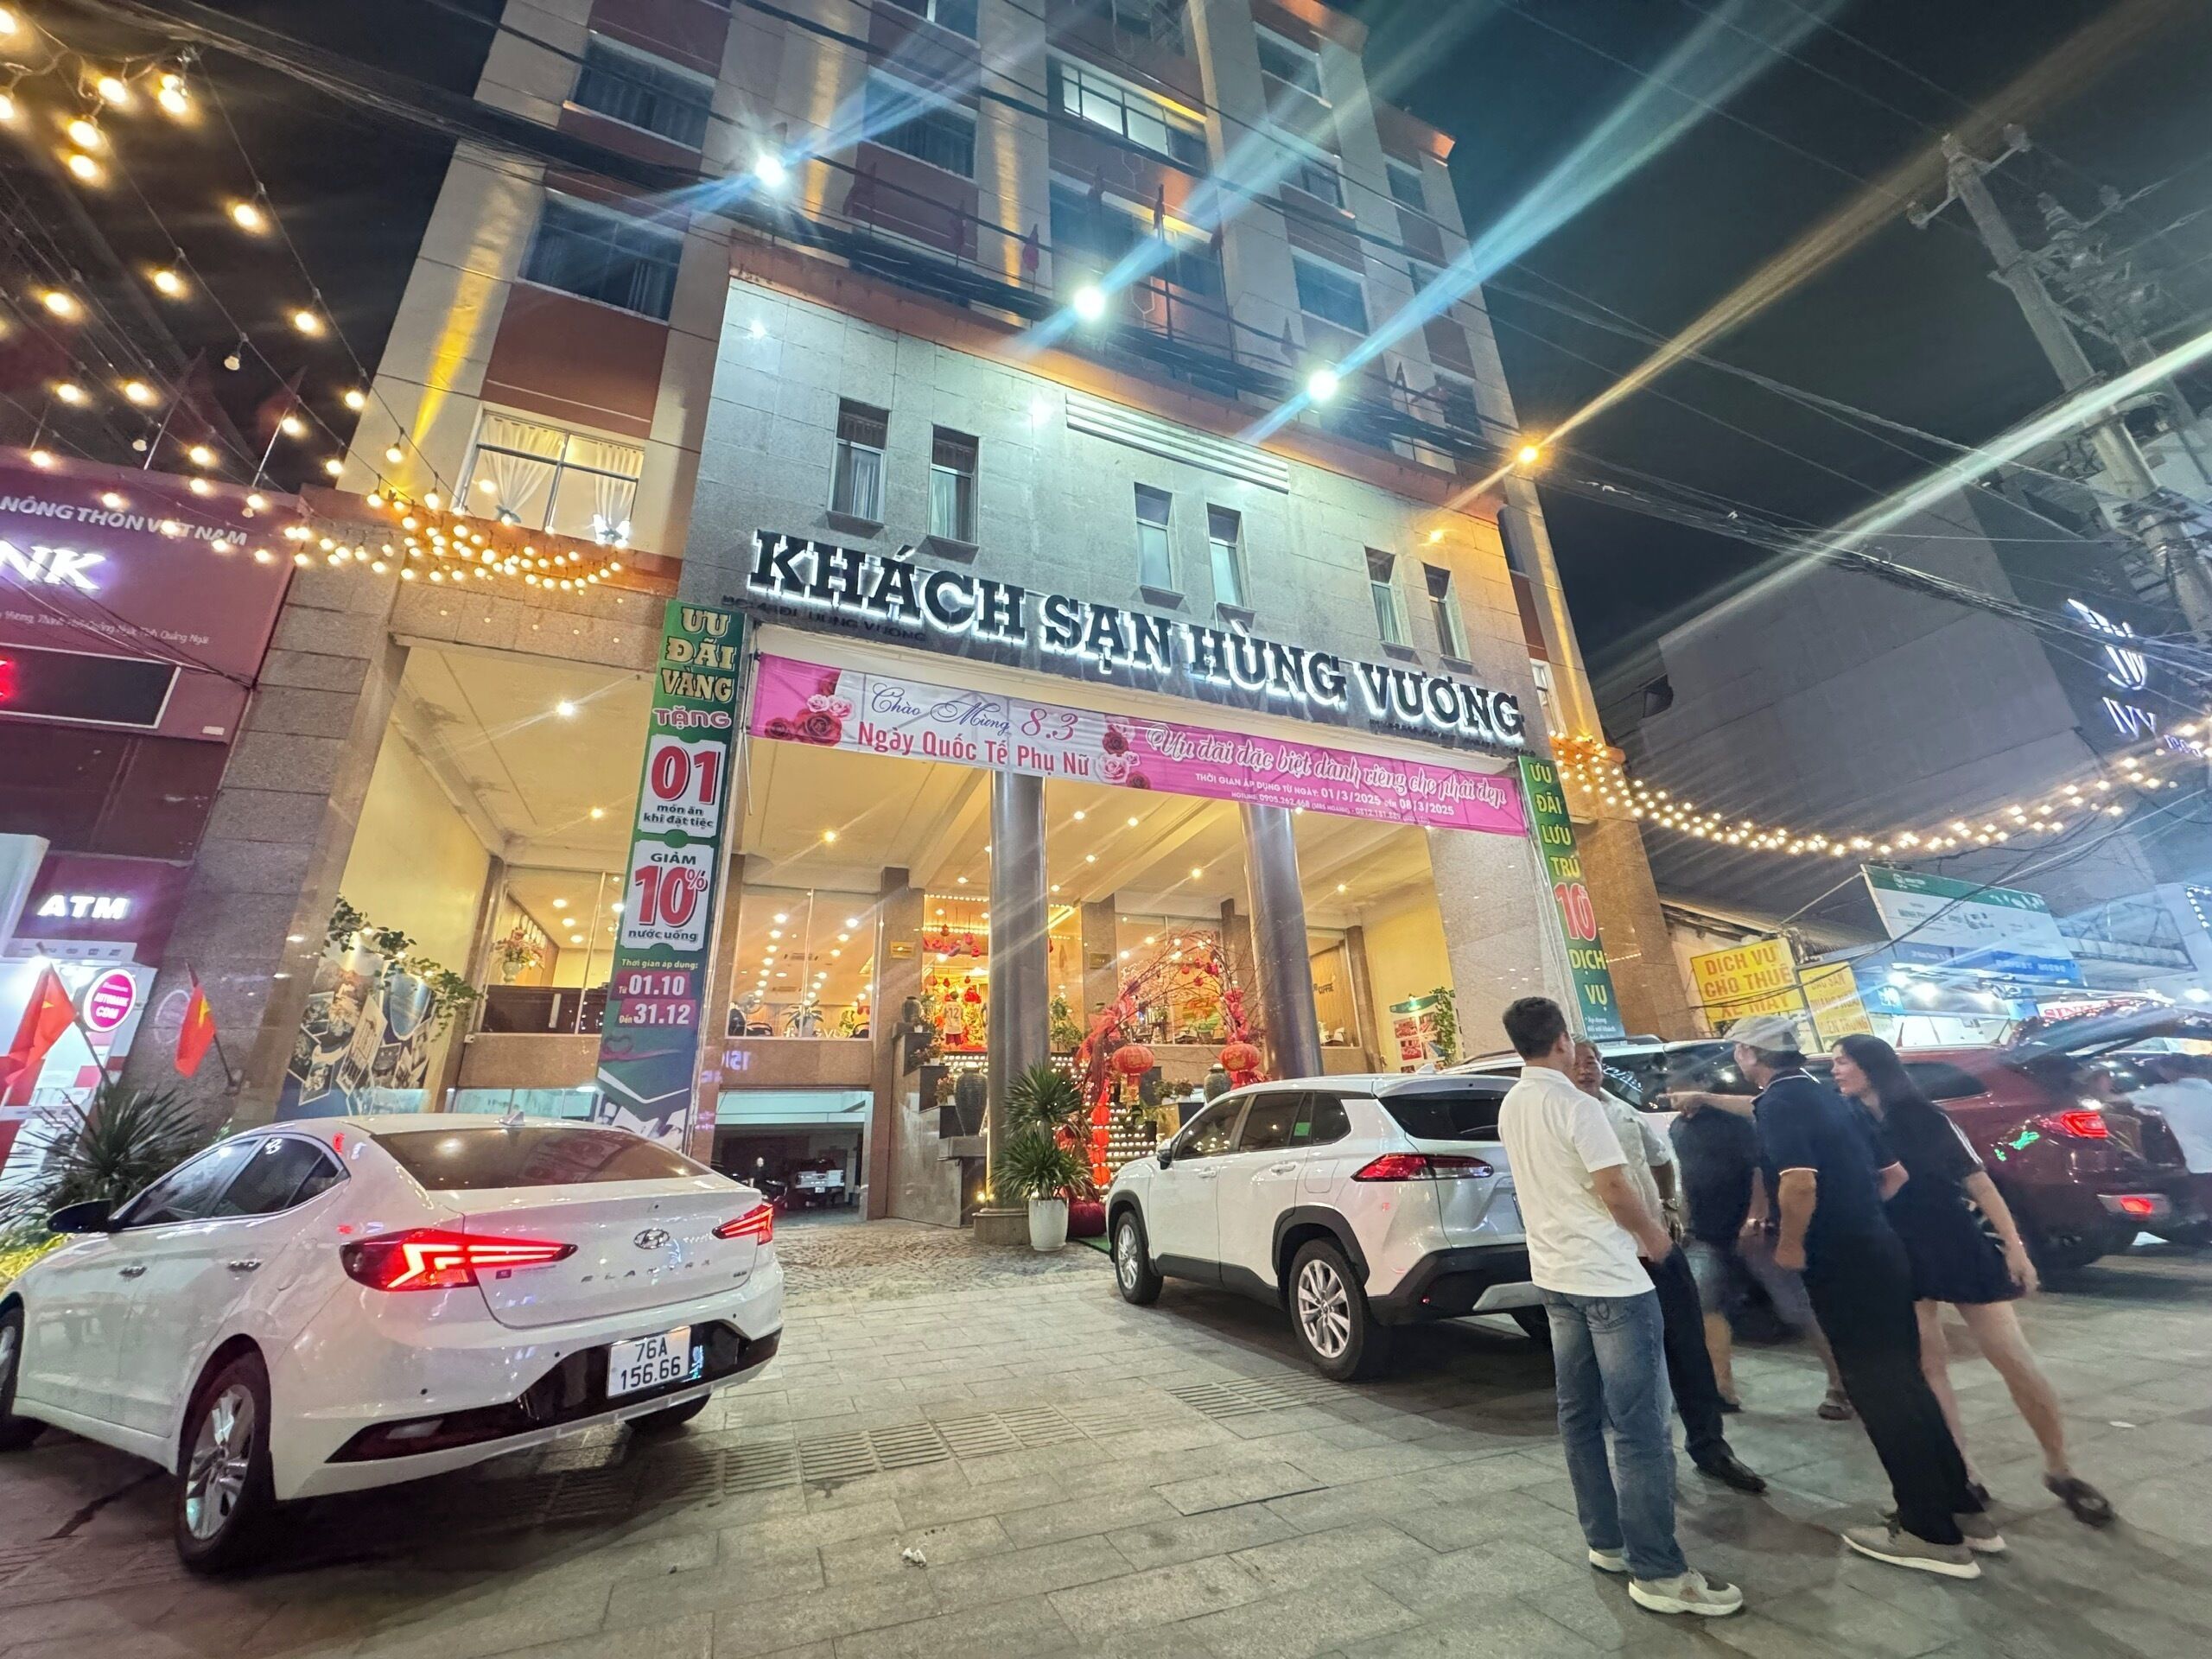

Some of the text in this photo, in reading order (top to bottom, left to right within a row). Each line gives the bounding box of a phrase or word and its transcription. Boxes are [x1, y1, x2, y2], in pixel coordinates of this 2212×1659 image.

[0, 495, 75, 519] NÔNG
[77, 506, 145, 531] THÔN
[680, 607, 730, 637] ƯU
[748, 529, 1027, 645] KHÁCH
[1040, 594, 1173, 674] SẠN
[1182, 618, 1349, 711] HÙNG
[1354, 660, 1527, 748] VƯƠNG
[664, 637, 736, 670] ĐÃI
[660, 665, 734, 703] VÀNG
[652, 705, 732, 729] TẶNG
[871, 682, 1079, 741] Chào Mừng 8.3
[857, 721, 1090, 777] Ngày Quốc Tế Phụ Nữ
[651, 745, 721, 805] 01
[1195, 772, 1217, 784] THỜI
[1218, 776, 1242, 786] GIAN
[1197, 734, 1235, 765] đãi
[1235, 739, 1274, 773] đặc
[1276, 745, 1313, 779] biệt
[1314, 750, 1361, 790] dành
[1408, 766, 1437, 799] cho
[1477, 777, 1507, 810] đẹp
[1529, 762, 1552, 784] ƯU
[657, 803, 703, 816] món ăn
[1536, 793, 1563, 815] ĐÃI
[643, 812, 714, 830] khi đặt tiệc
[1542, 823, 1572, 847] LƯU
[651, 851, 696, 865] GIẢM
[1550, 854, 1582, 879] TRÚ
[37, 894, 129, 920] ATM
[635, 865, 709, 929] 10%
[628, 929, 698, 943] nước uống
[641, 959, 661, 969] gian
[1569, 949, 1607, 976] DỊCH
[1705, 944, 1779, 977] DỊCH VỤ
[628, 974, 685, 995] 01.10
[1703, 963, 1796, 998] CHO THUÊ
[1584, 984, 1609, 1011] VỤ
[633, 1003, 690, 1025] 31.12
[635, 1337, 668, 1363] 76A
[620, 1356, 681, 1390] 156.66
